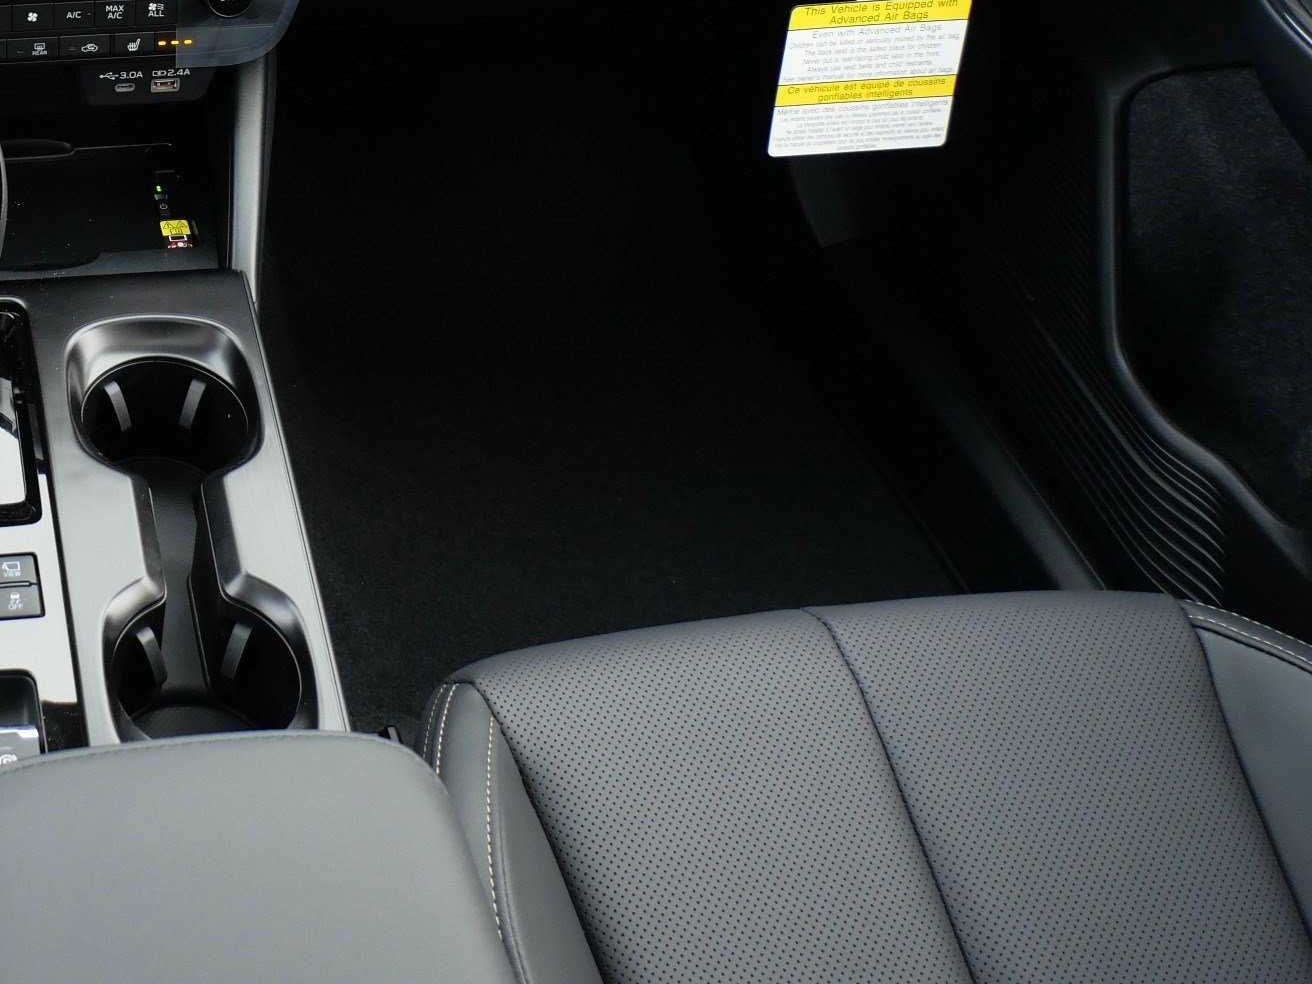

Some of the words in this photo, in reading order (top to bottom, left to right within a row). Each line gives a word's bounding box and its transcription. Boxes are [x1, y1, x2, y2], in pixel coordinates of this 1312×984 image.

[805, 7, 826, 16] This
[831, 4, 868, 14] Vehicle
[885, 0, 933, 11] Equipped
[66, 11, 82, 19] A/C
[830, 13, 880, 25] Advanced
[884, 12, 899, 21] Air
[903, 11, 928, 22] Bags
[812, 30, 833, 39] Even
[837, 29, 855, 37] with
[859, 25, 900, 35] Advanced
[905, 24, 916, 32] Air
[789, 42, 813, 50] Children
[119, 71, 143, 80] 3.0A
[167, 69, 191, 77] 2.4A
[788, 86, 800, 95] Ce
[804, 83, 840, 93] véhicule
[844, 83, 857, 91] est
[860, 79, 890, 90] équipé
[908, 77, 946, 87] coussins
[818, 92, 863, 102] gonflables
[866, 88, 913, 99] intelligents
[838, 104, 869, 112] coussins
[872, 101, 908, 112] gonflables
[911, 99, 949, 108] intelligents
[8, 603, 24, 611] OFF
